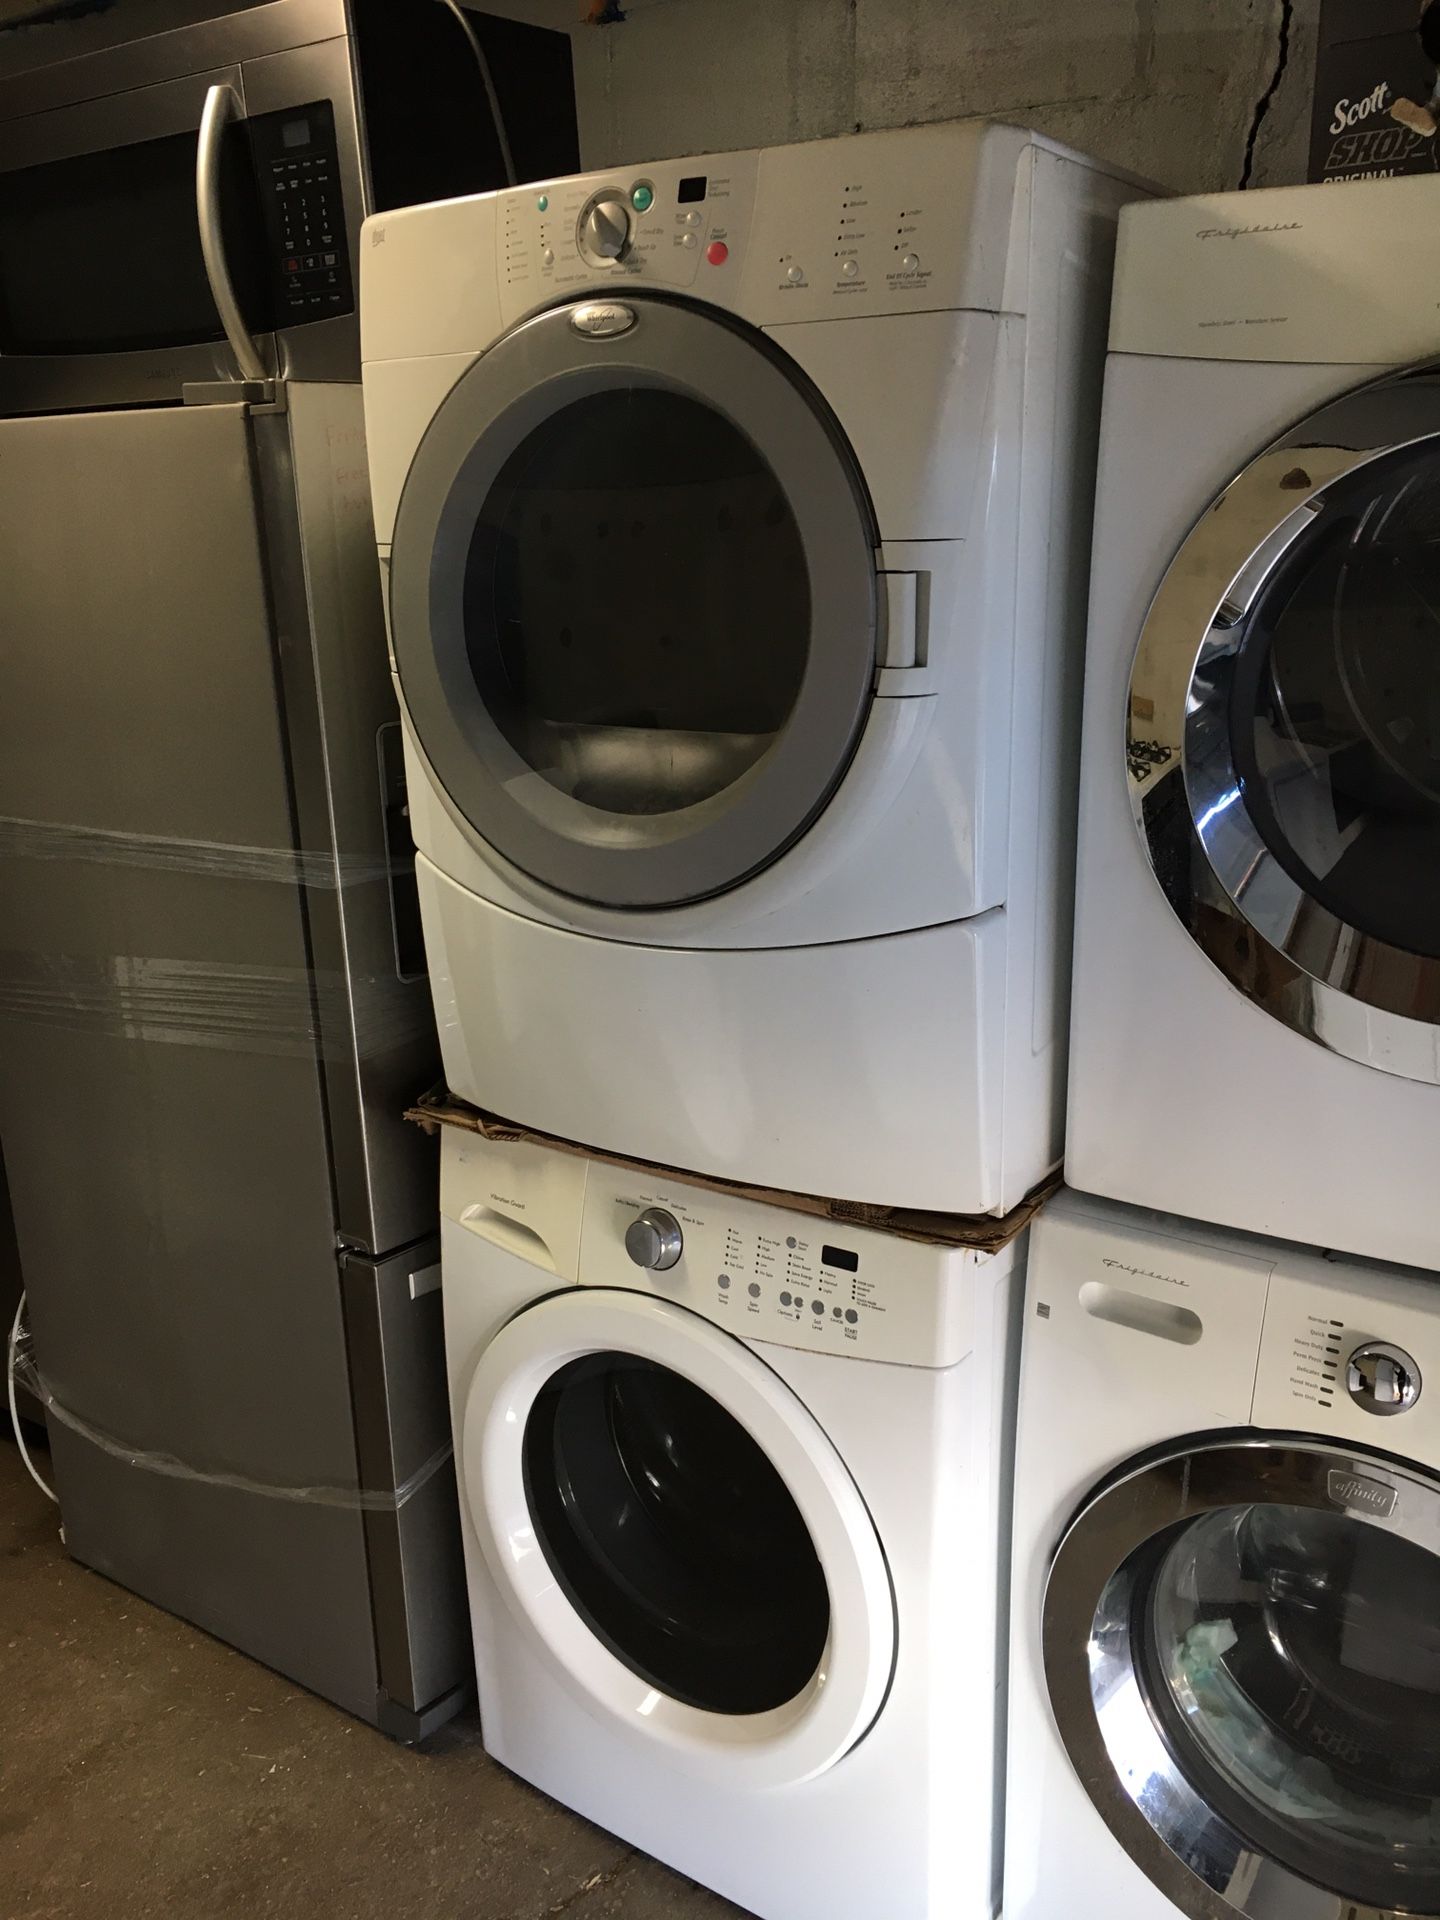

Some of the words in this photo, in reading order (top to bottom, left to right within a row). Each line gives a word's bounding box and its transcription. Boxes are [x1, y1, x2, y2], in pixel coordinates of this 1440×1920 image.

[1329, 81, 1388, 135] Scott
[1324, 127, 1424, 170] SHOP
[1196, 222, 1303, 240] Frigidaire
[1102, 1258, 1190, 1287] Frigidaire
[1310, 1329, 1325, 1338] Quick
[1335, 1480, 1387, 1508] affinity
